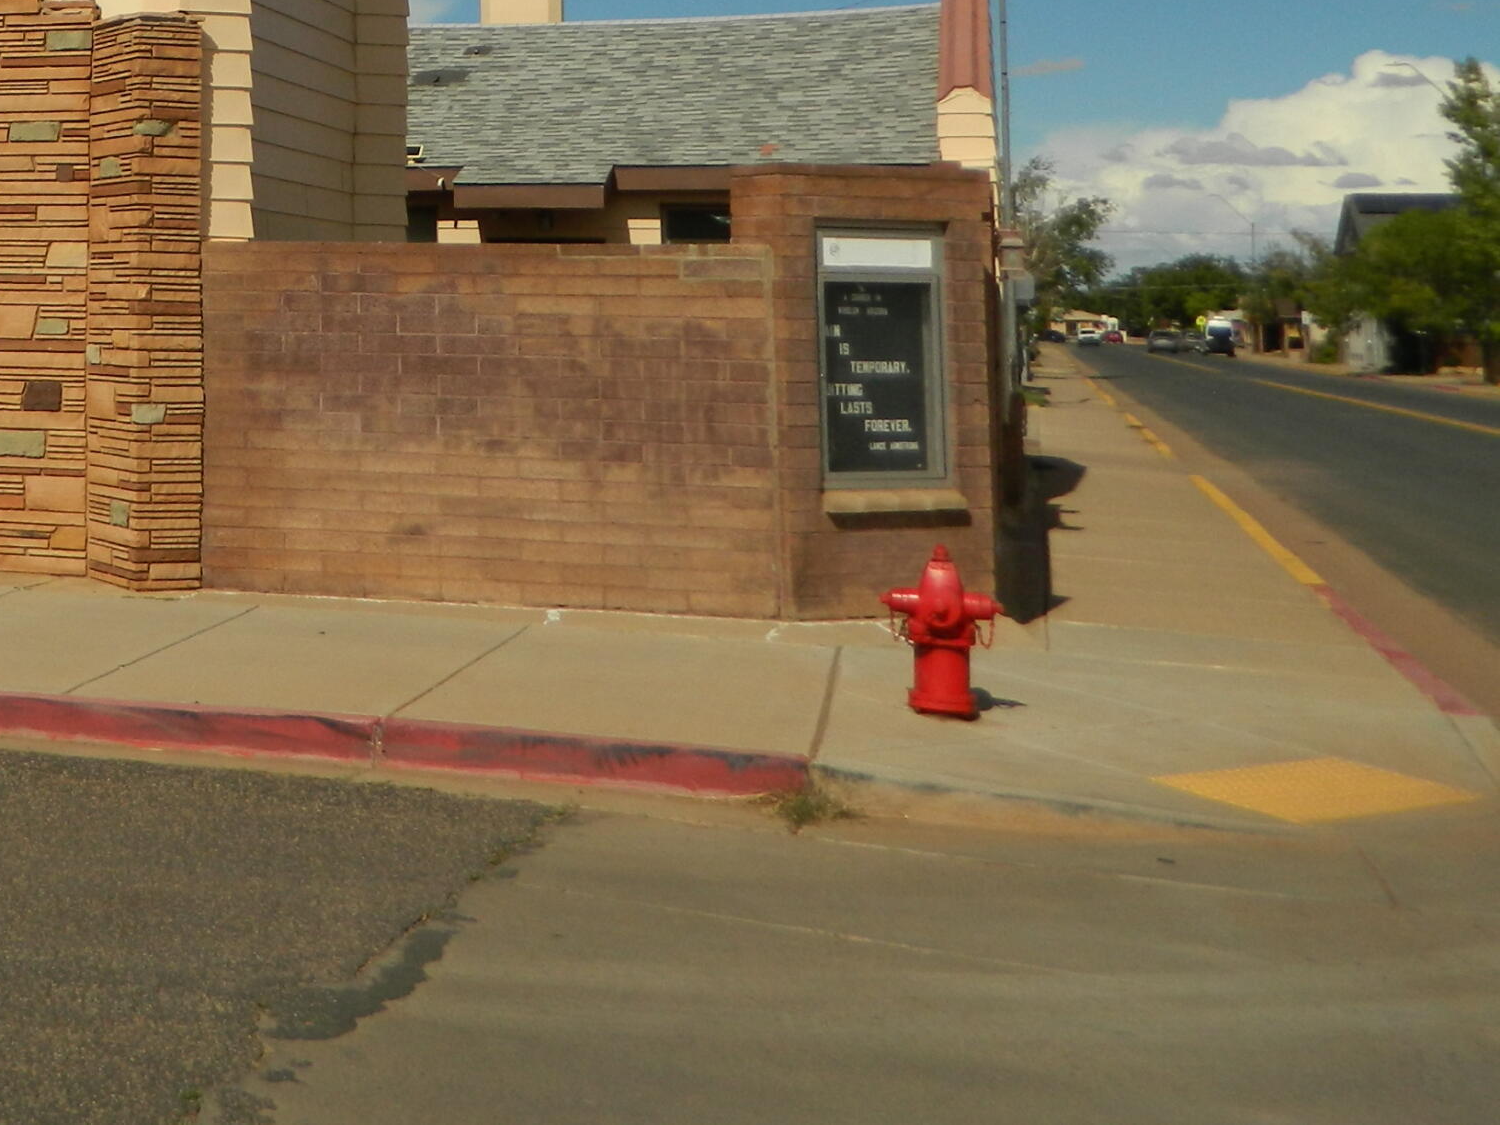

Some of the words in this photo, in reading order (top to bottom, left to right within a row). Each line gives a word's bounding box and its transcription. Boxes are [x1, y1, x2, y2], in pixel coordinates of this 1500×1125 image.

[839, 343, 850, 355] IS
[851, 361, 911, 373] TEMPORARY.
[840, 402, 873, 414] LASTS
[864, 419, 912, 432] FOREVER.
